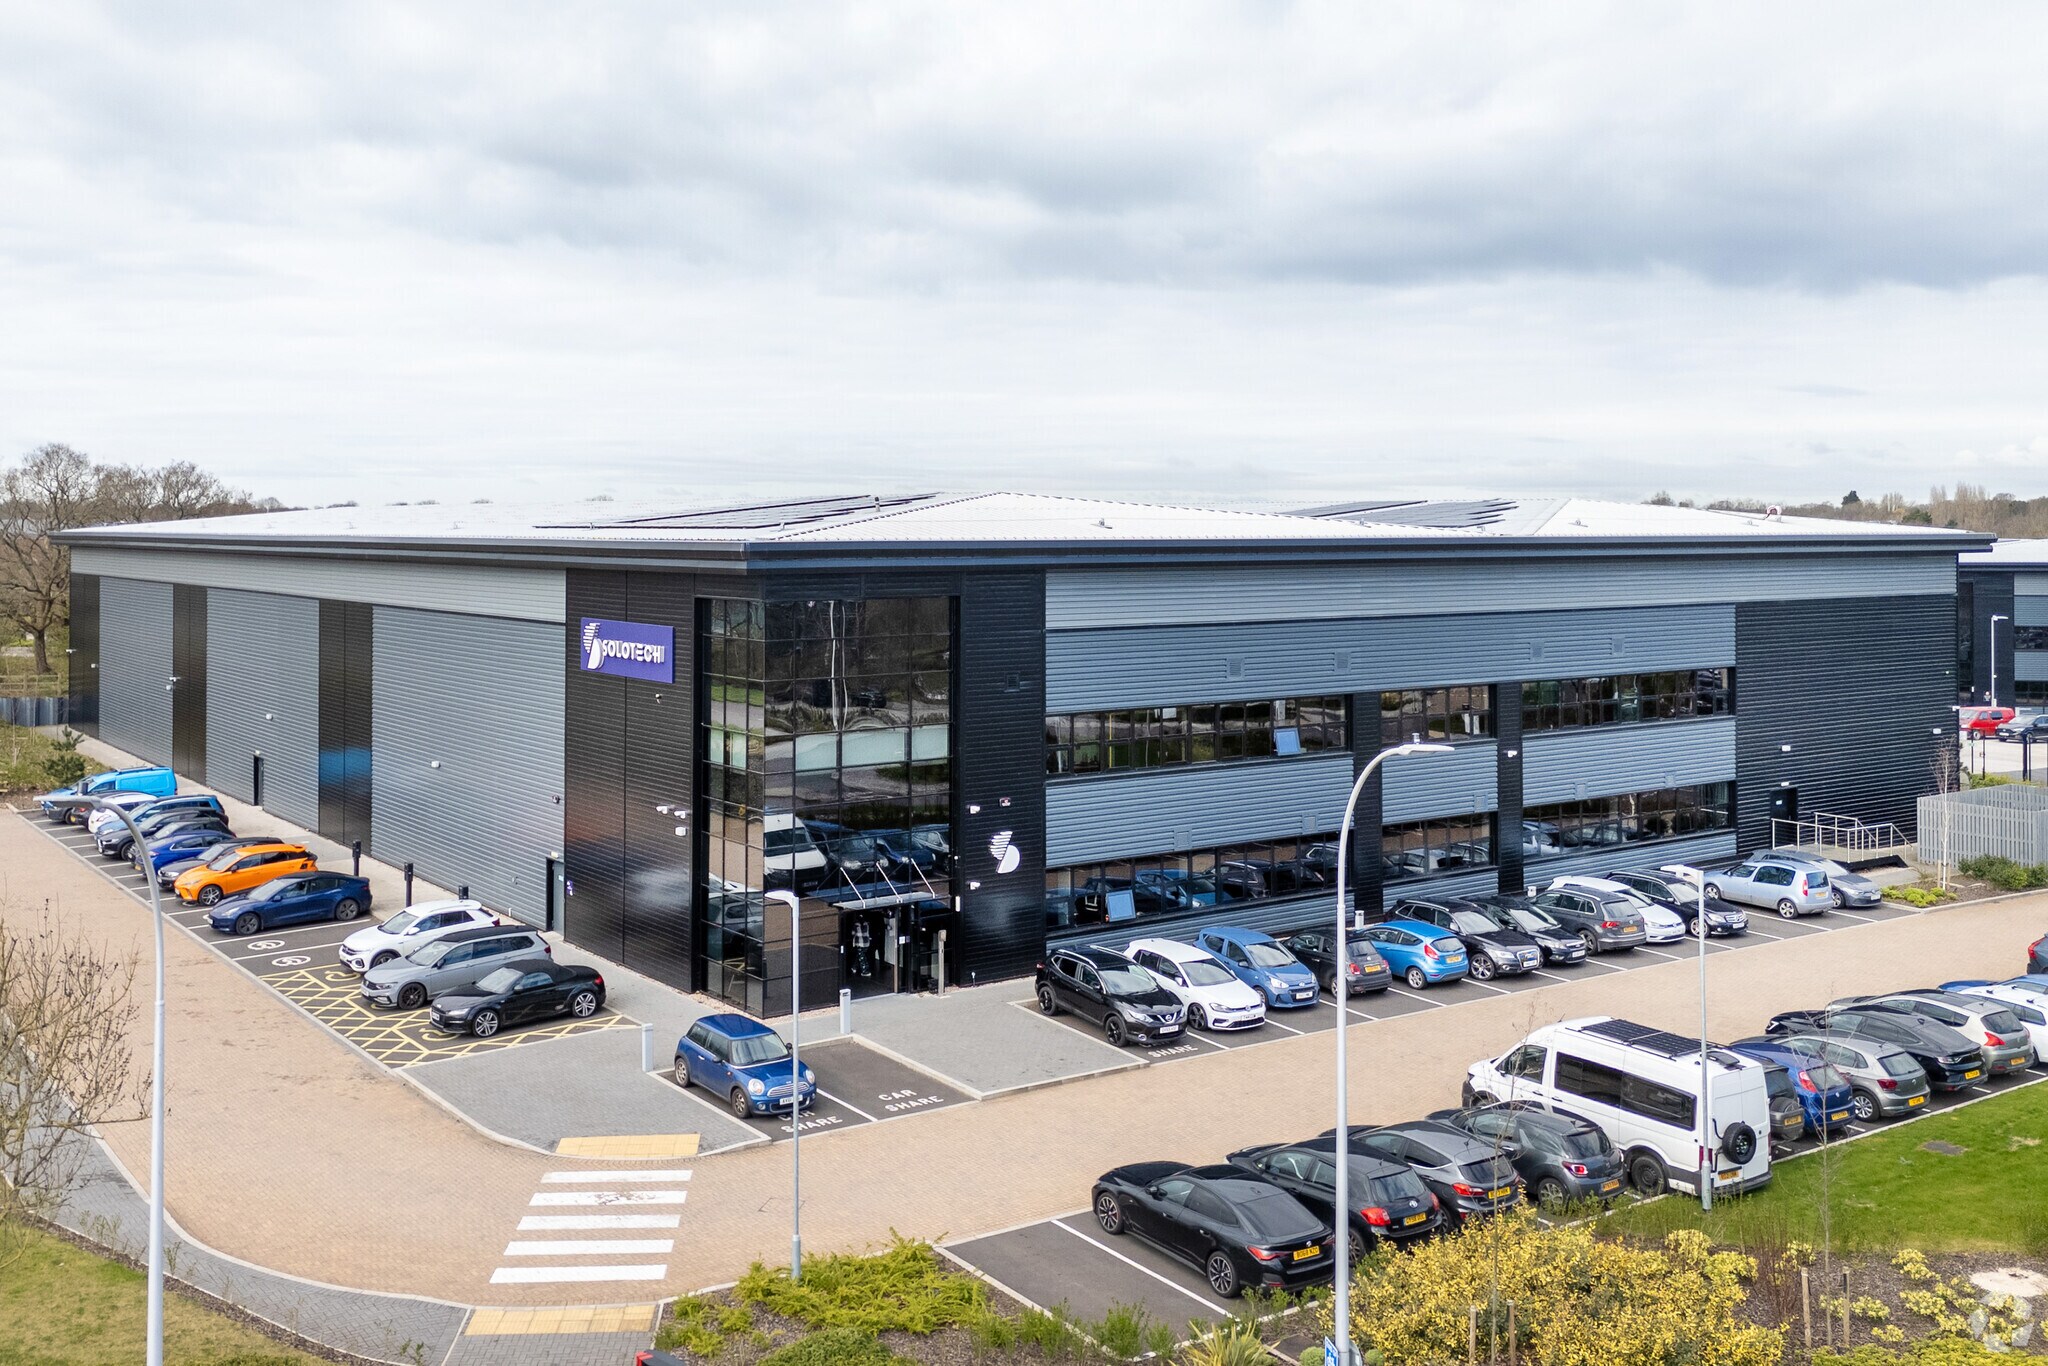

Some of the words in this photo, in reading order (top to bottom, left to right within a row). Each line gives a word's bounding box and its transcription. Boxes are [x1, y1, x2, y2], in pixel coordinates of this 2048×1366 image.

[602, 639, 664, 664] SOLOTECH
[1148, 1044, 1199, 1057] SHARE
[878, 1089, 918, 1101] CAR
[885, 1095, 944, 1111] SHARE
